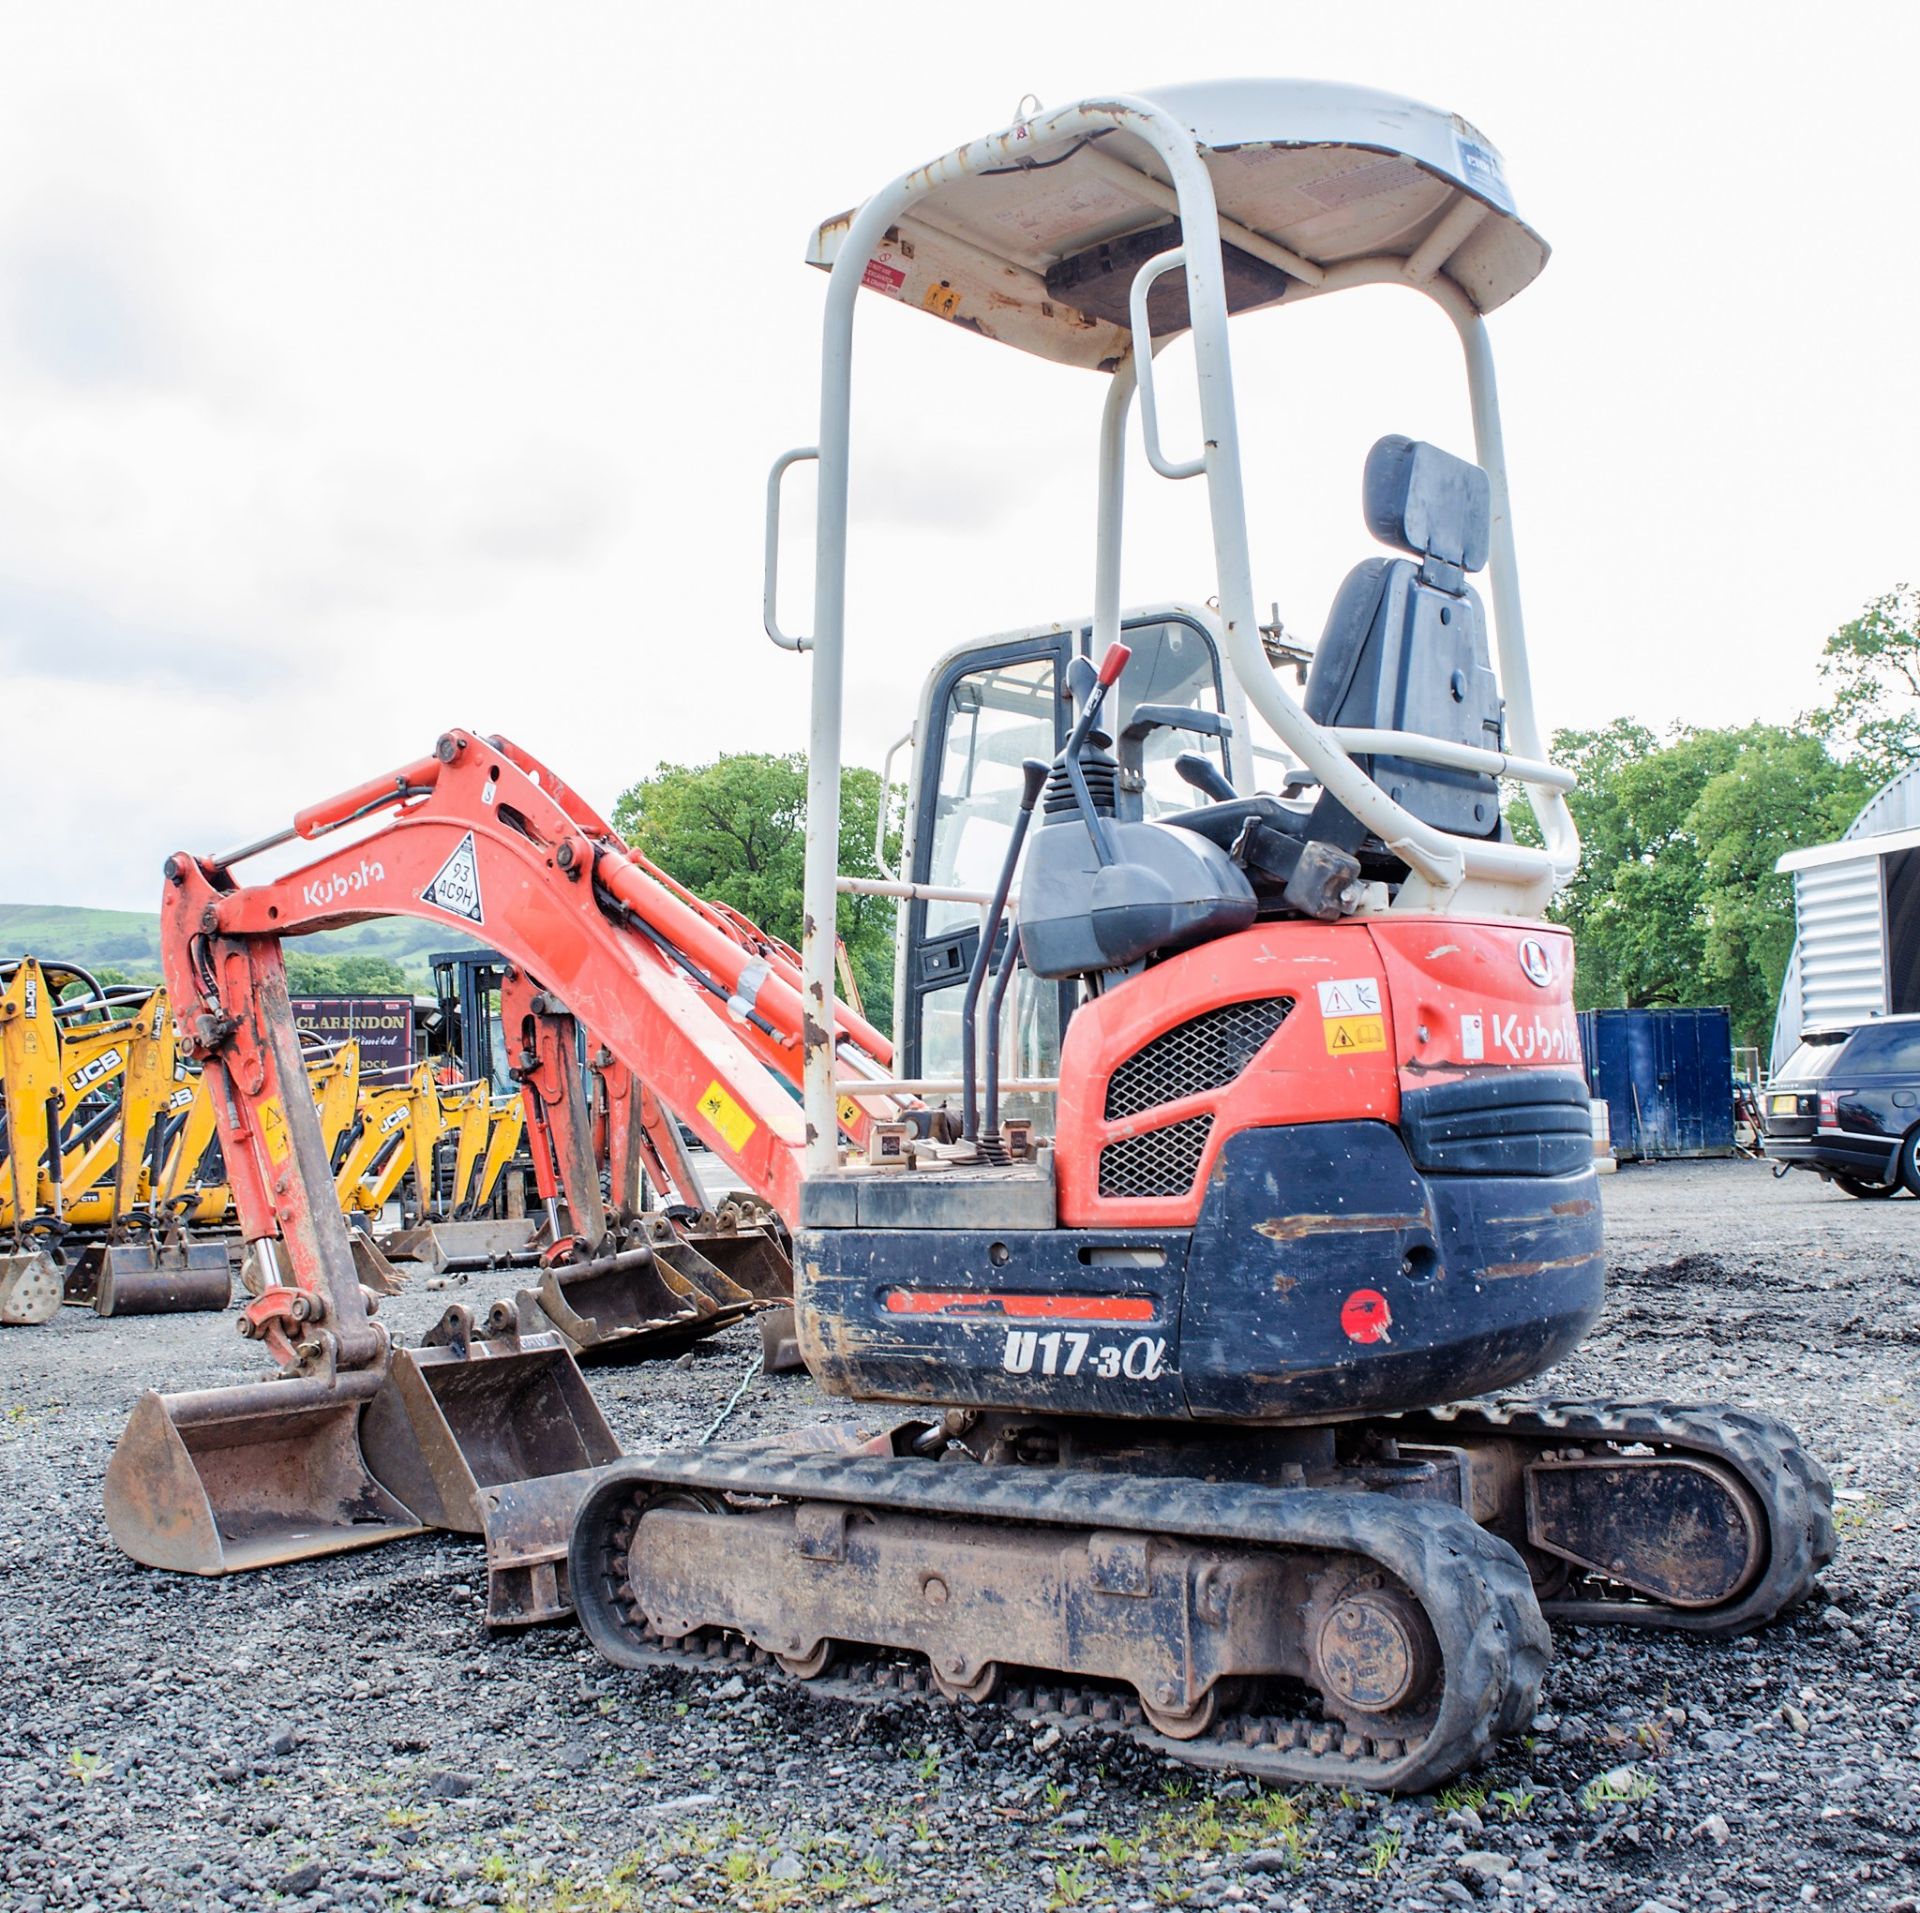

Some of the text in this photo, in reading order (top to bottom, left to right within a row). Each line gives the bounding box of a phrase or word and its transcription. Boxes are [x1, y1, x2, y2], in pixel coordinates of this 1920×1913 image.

[303, 860, 385, 907] Kubota
[453, 863, 470, 882] 93
[439, 879, 472, 907] AC9H
[296, 1016, 405, 1030] CLARENDON
[70, 1049, 123, 1091] JCB
[380, 1105, 410, 1133] JCB
